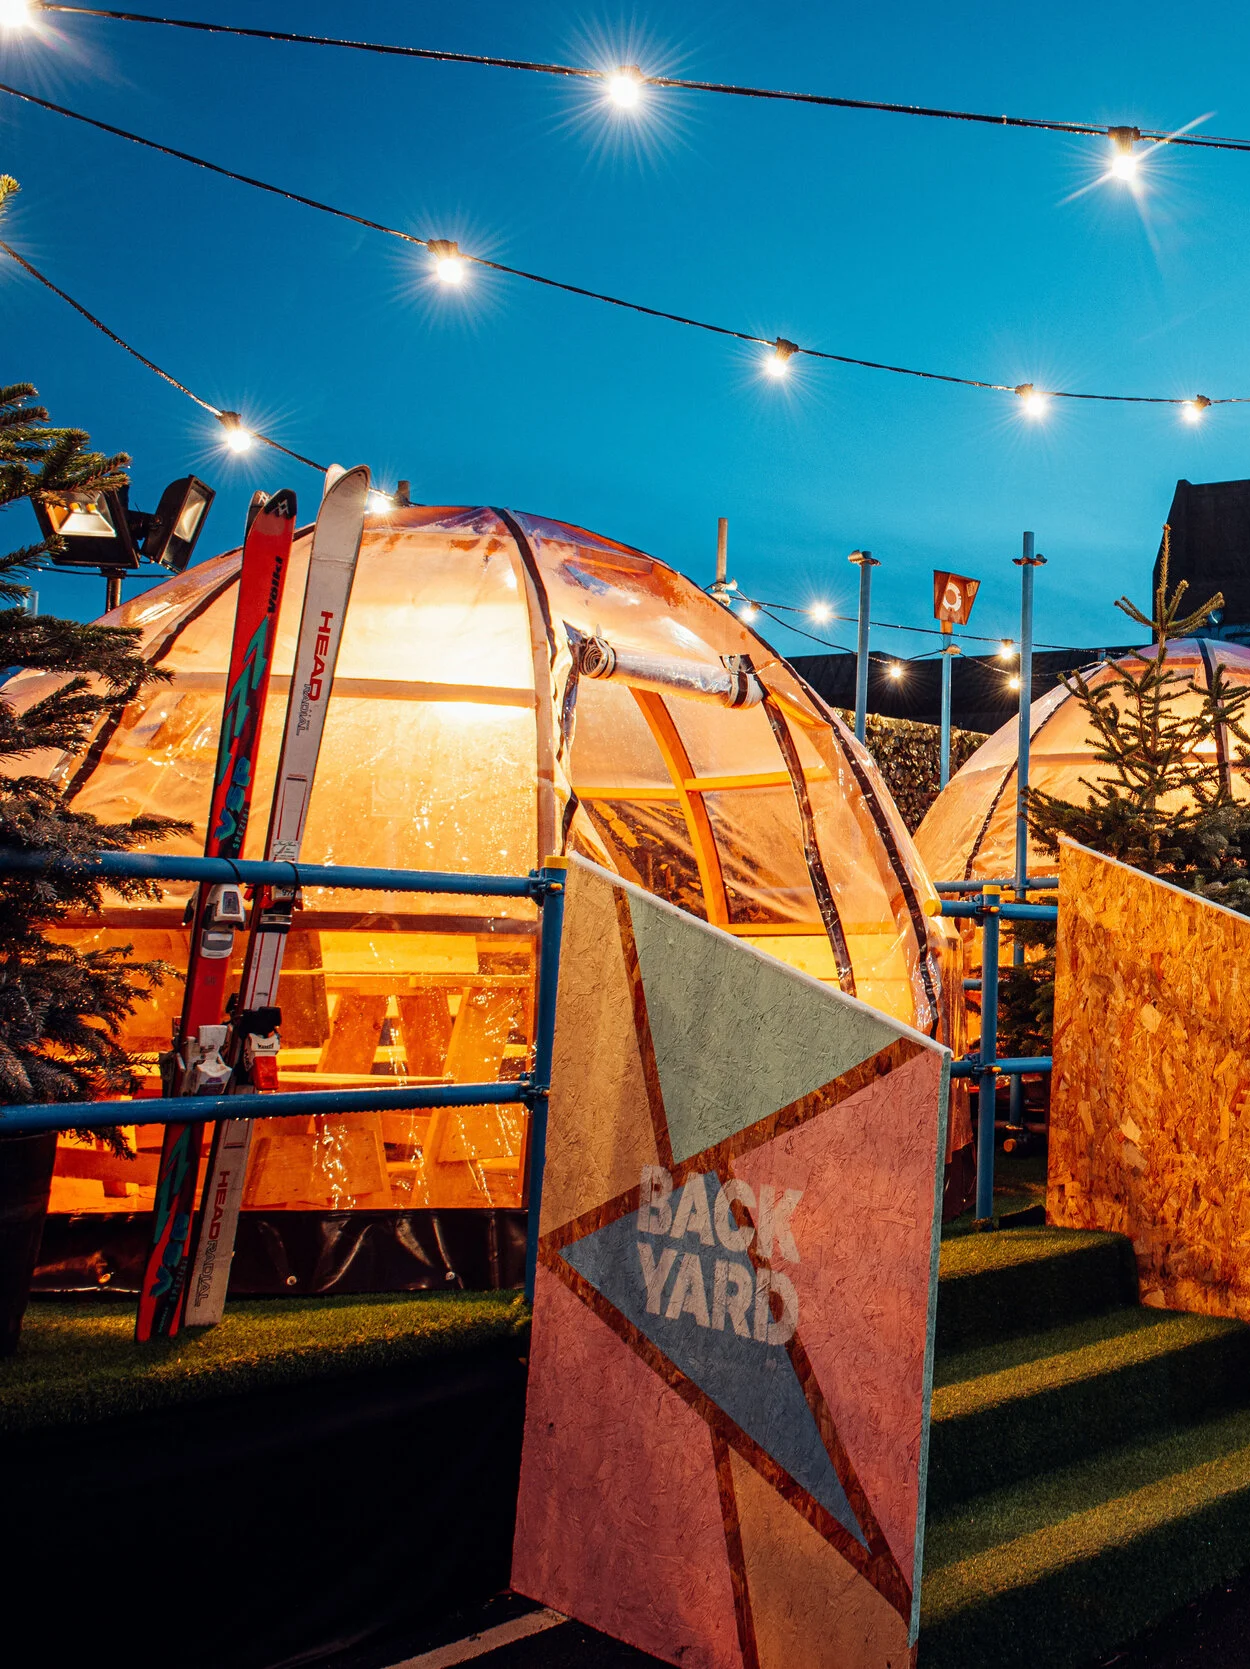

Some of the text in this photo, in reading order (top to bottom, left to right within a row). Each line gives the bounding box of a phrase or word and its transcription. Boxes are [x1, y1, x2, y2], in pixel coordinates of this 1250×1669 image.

[309, 610, 334, 701] HEAD
[201, 1170, 231, 1301] HEAD RADIAL
[636, 1164, 804, 1264] BACK
[636, 1242, 800, 1346] YARD
